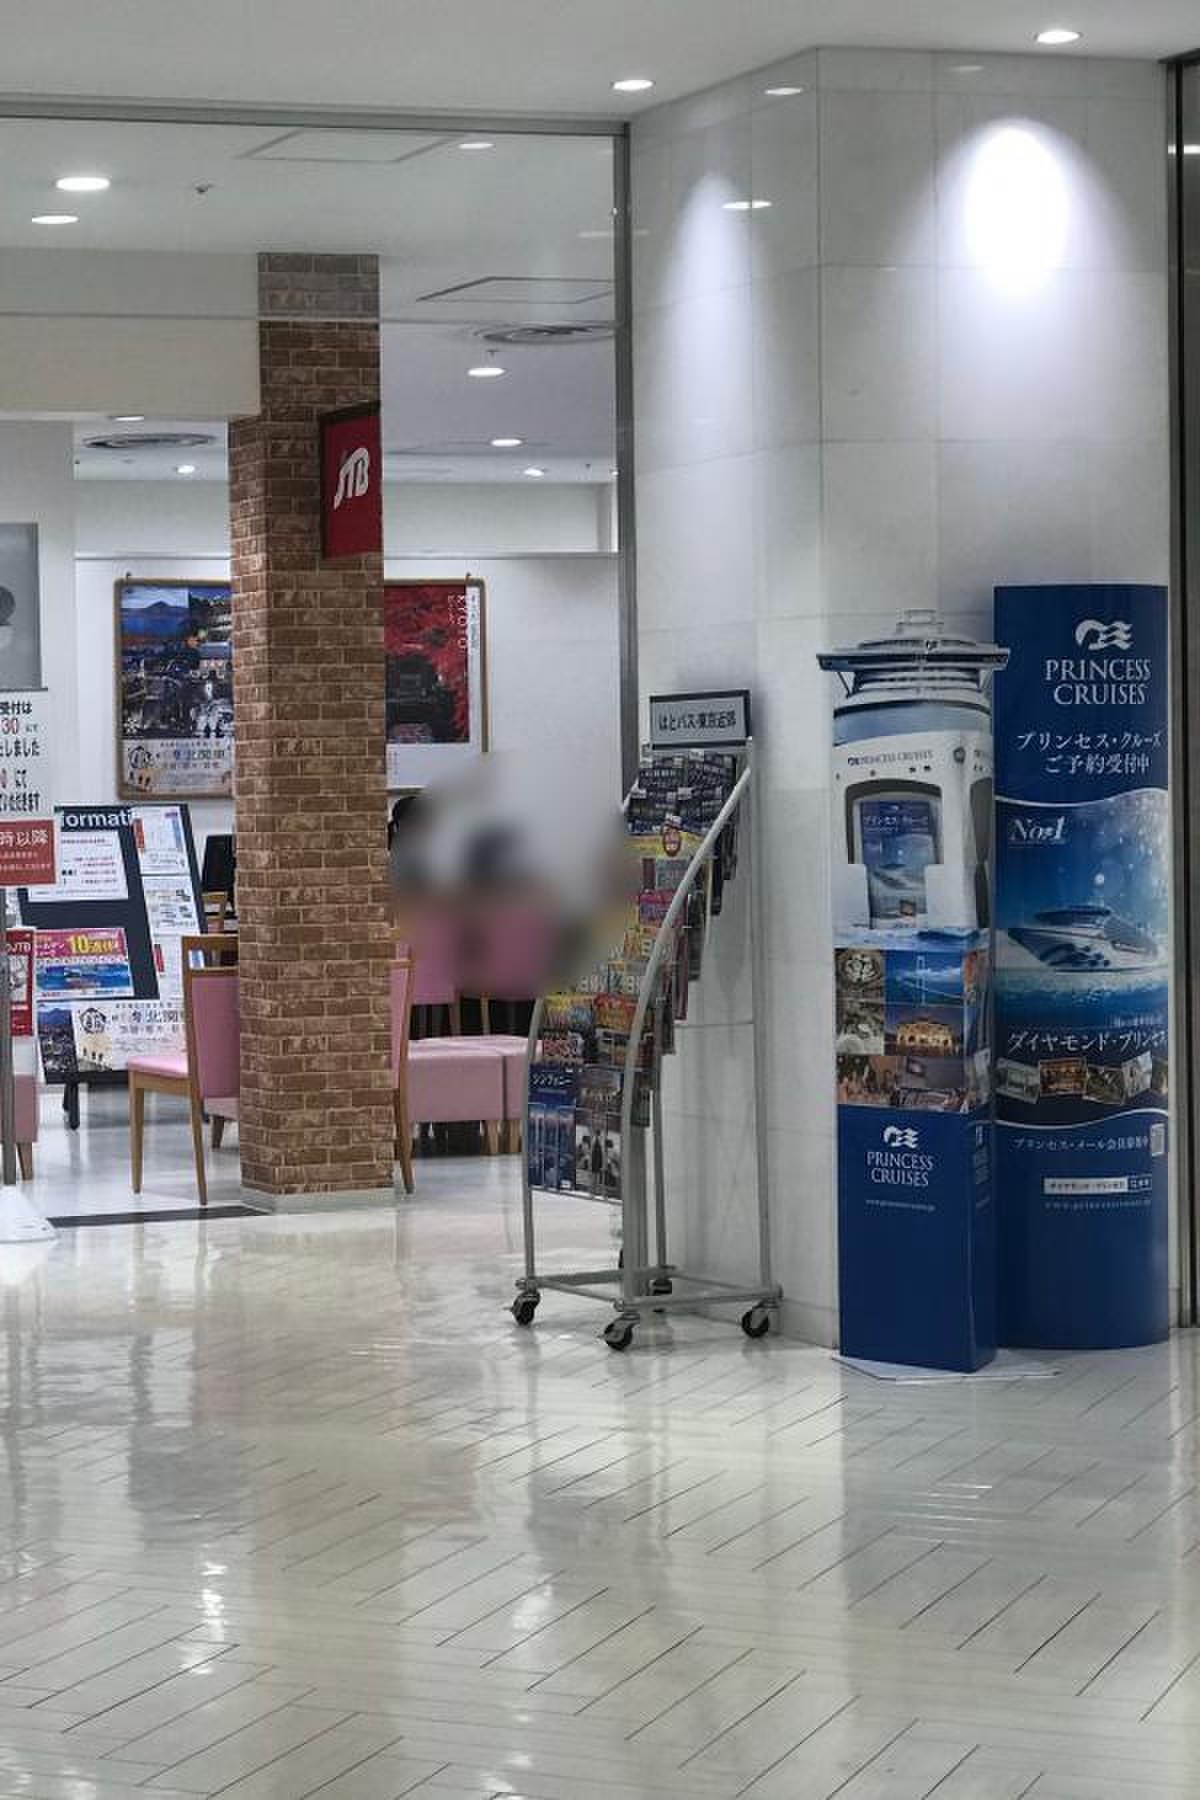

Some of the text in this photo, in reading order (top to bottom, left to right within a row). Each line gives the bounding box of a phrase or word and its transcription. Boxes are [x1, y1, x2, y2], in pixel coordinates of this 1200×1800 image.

[333, 446, 371, 510] JTB
[1045, 658, 1151, 681] PRINCESS
[1053, 683, 1148, 705] CRUISES
[1016, 731, 1163, 751] プリンセス・クルーズ
[1045, 752, 1150, 775] ご予約受付中
[866, 1151, 935, 1171] PRINCESS
[870, 1167, 929, 1187] CRUISES
